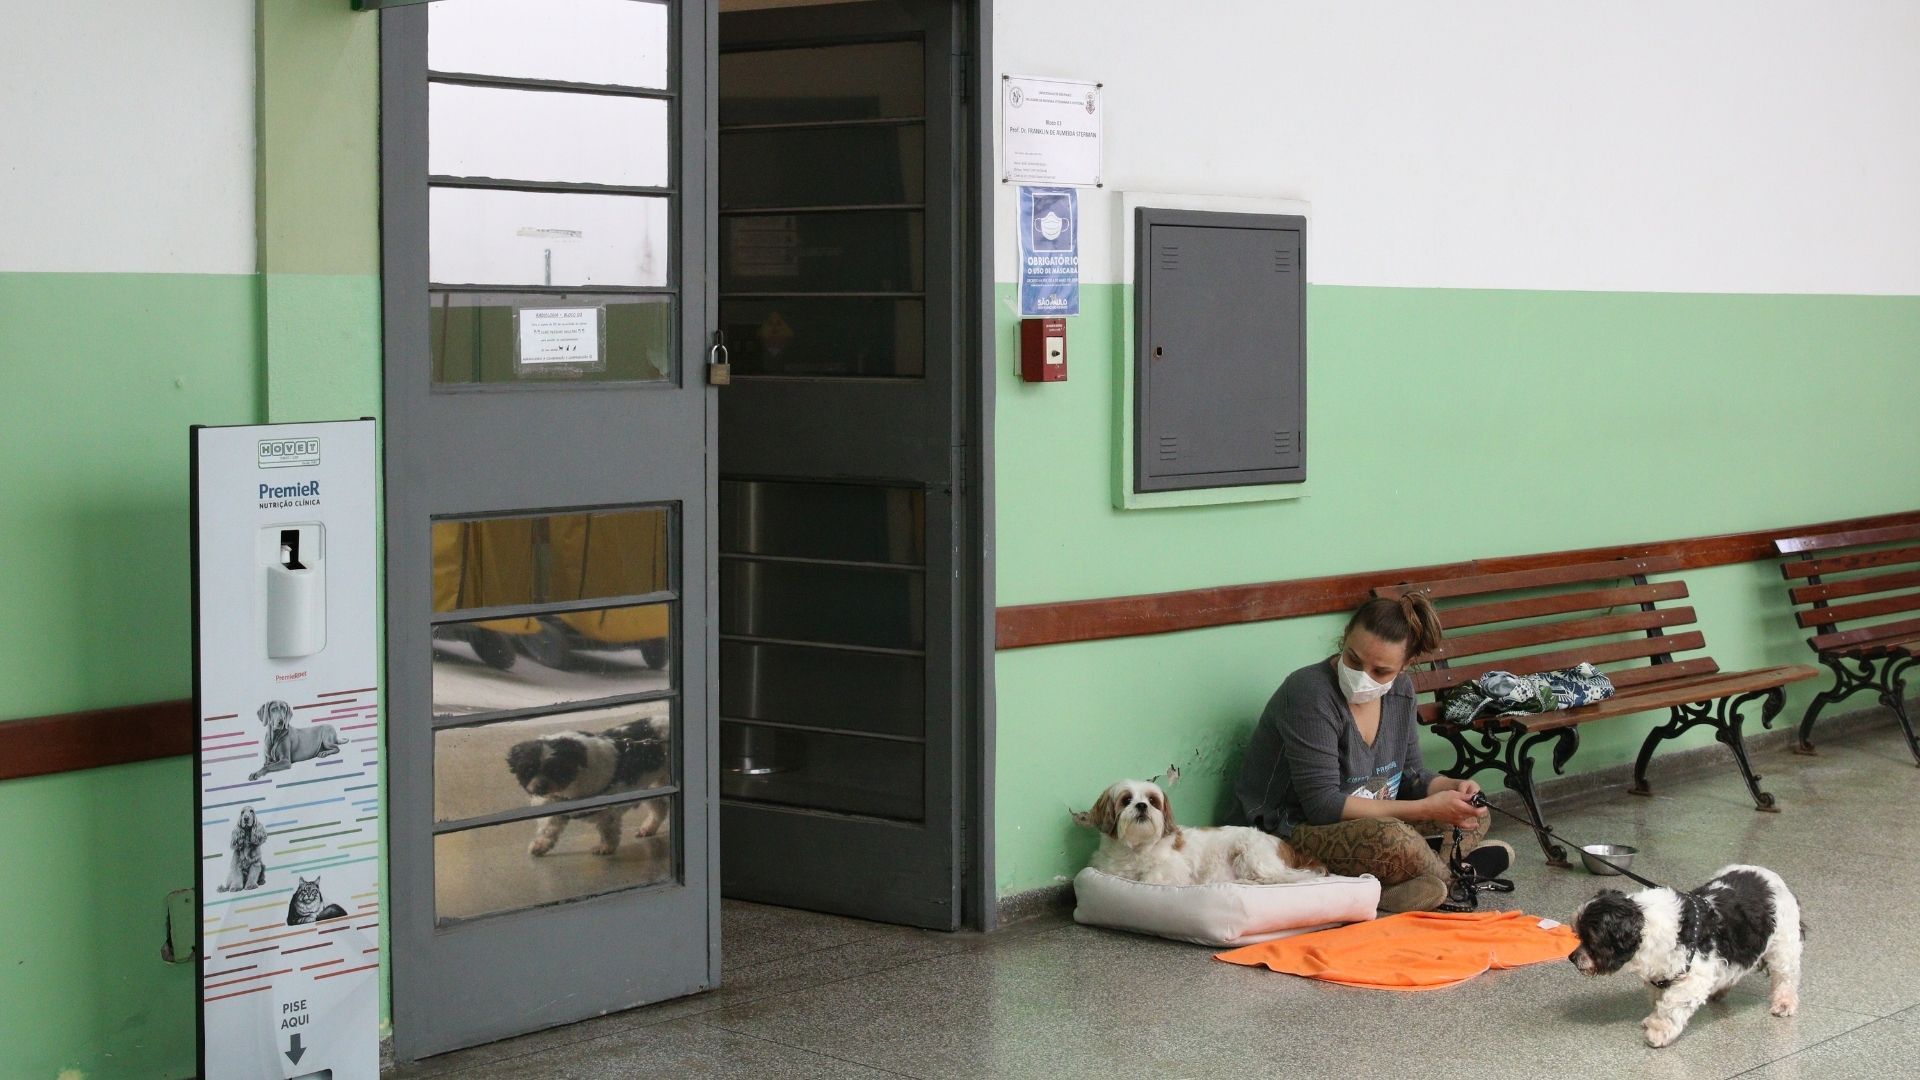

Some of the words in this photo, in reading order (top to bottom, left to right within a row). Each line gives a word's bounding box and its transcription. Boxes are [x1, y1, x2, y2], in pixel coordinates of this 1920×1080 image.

[1027, 127, 1049, 135] FRANKLIN
[1027, 254, 1079, 266] OBRIGATÓRIO
[1052, 265, 1078, 274] MÁSCARA
[1037, 297, 1050, 306] SÃO
[261, 443, 317, 454] HOVET
[259, 480, 320, 499] PremieR
[259, 500, 293, 509] NUTRIÇÃO
[295, 499, 321, 507] CLÍNICA
[282, 1000, 307, 1014] PISE
[280, 1014, 309, 1030] AQUI
